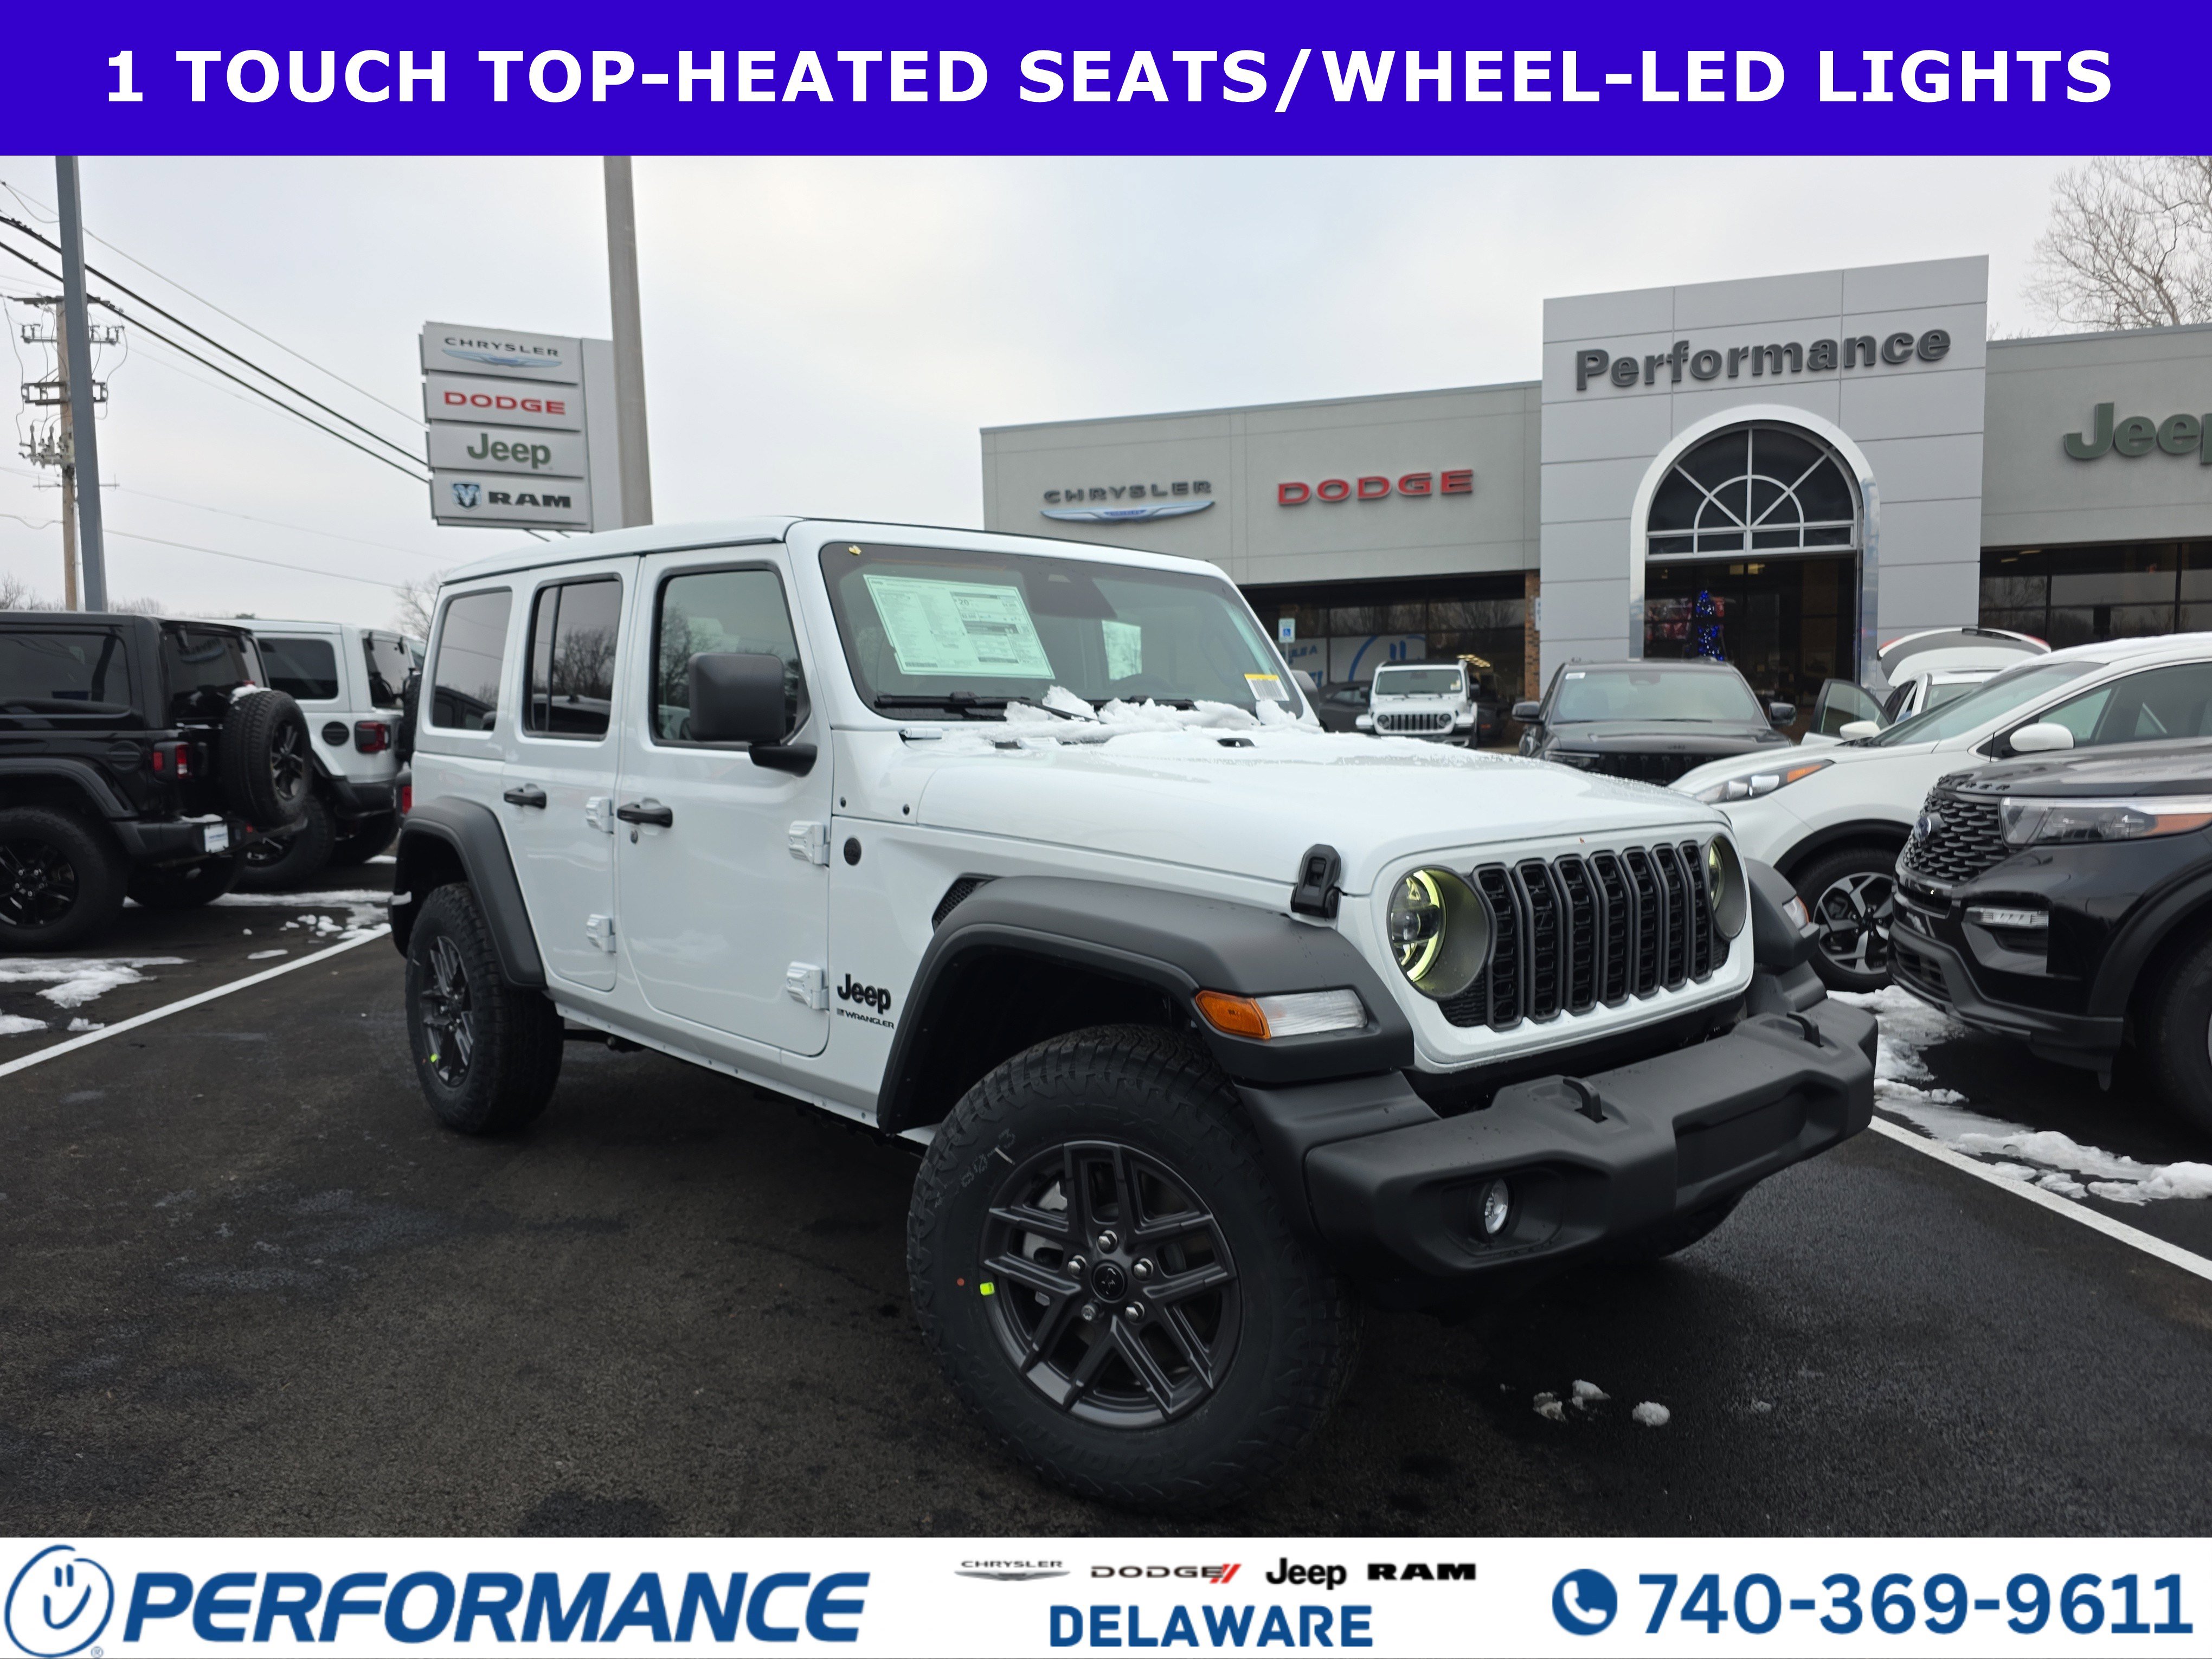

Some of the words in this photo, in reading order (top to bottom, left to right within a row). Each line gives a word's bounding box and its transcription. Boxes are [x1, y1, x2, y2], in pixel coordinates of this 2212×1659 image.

[445, 337, 560, 357] CHRYSLER
[1576, 329, 1951, 391] Performance
[443, 391, 566, 415] DODGE
[2063, 401, 2212, 465] Jee
[467, 433, 551, 470] Jeep
[488, 491, 571, 509] RAM
[1043, 480, 1212, 503] CHRYSLER
[1278, 468, 1473, 505] DODGE
[837, 973, 891, 1015] Jeep
[844, 1009, 895, 1030] WRANGLER
